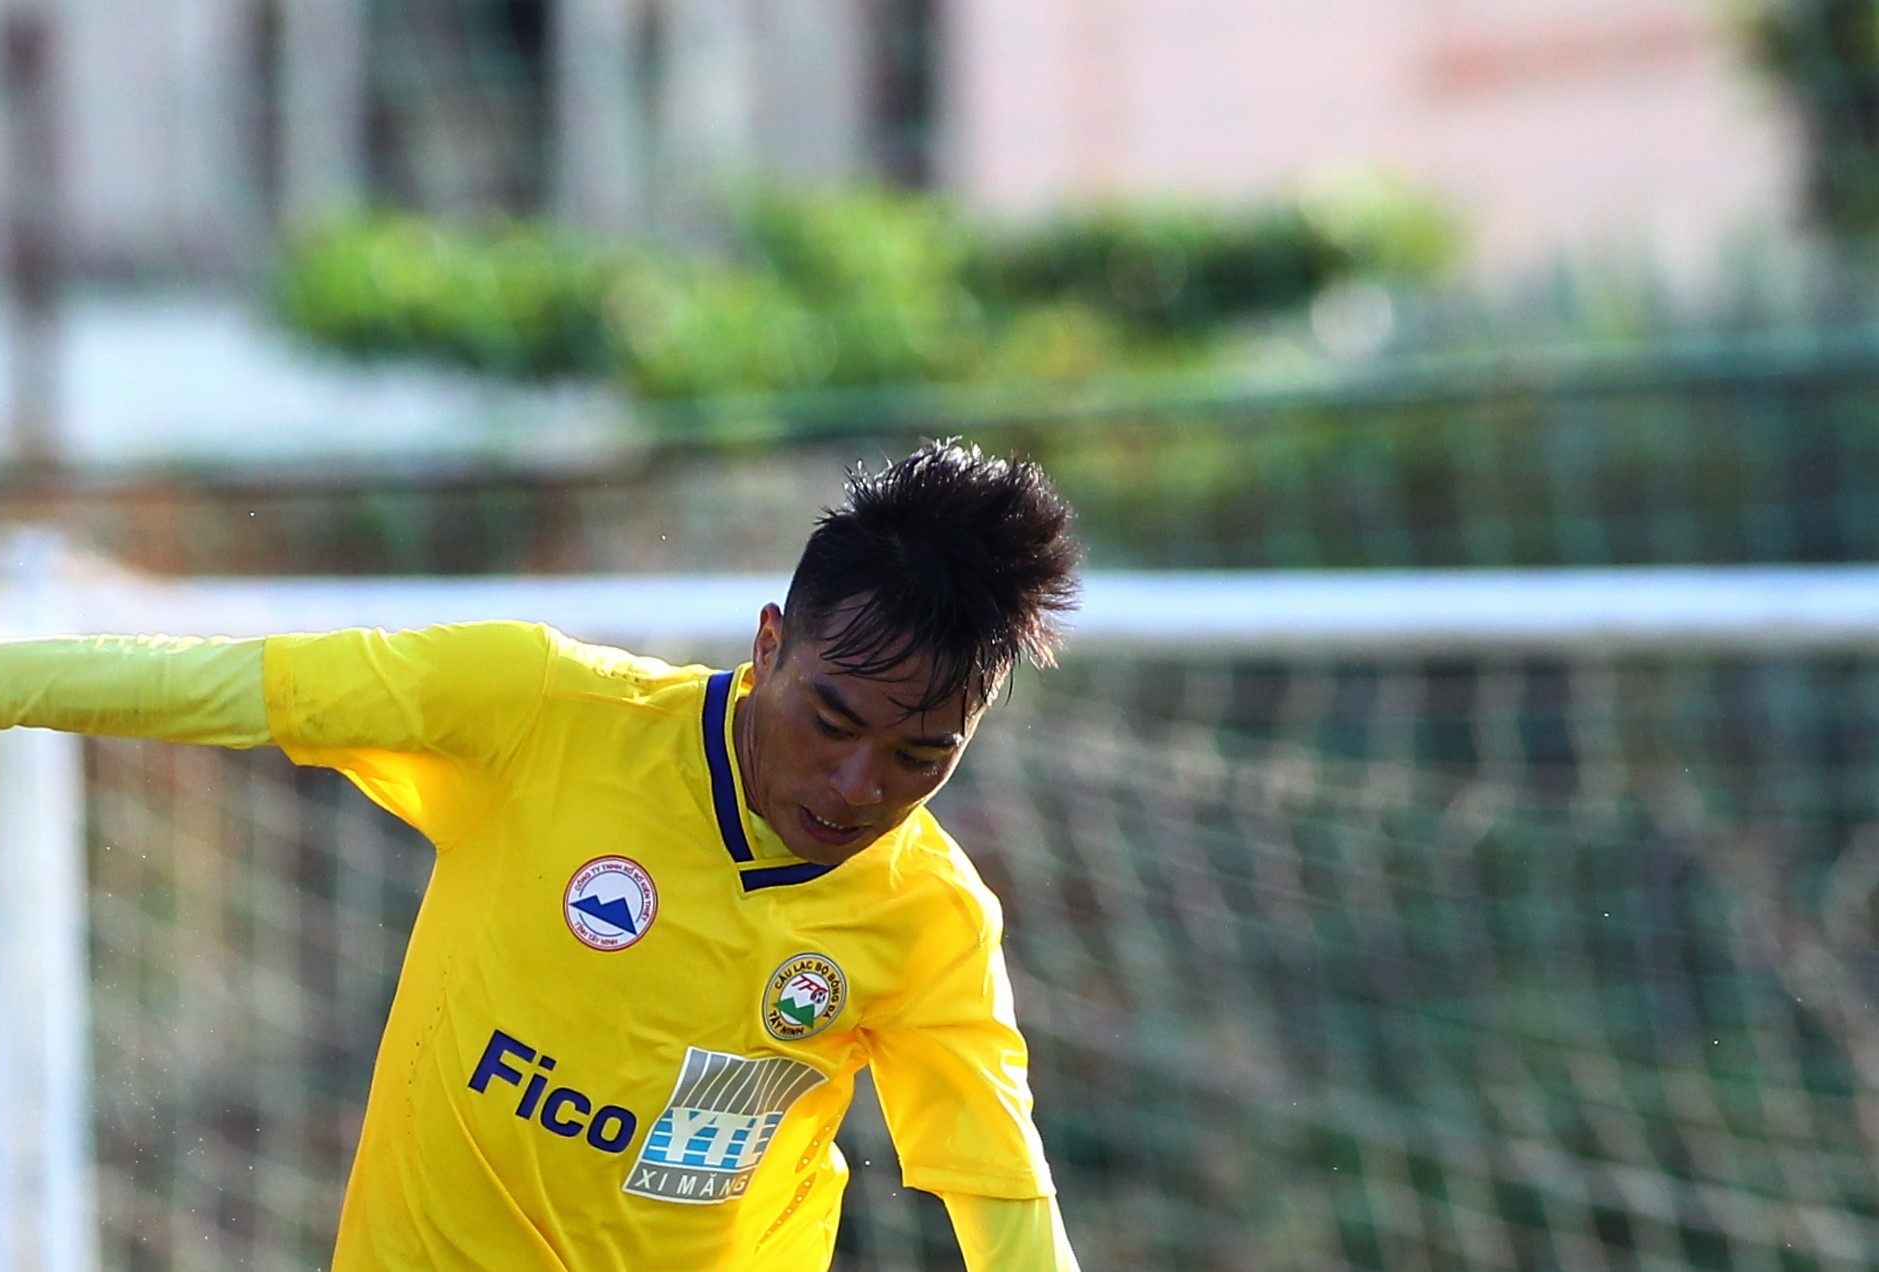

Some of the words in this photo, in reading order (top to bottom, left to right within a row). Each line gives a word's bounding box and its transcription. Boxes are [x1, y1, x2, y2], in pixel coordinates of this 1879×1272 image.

[467, 1028, 638, 1154] Fico
[634, 1168, 670, 1193] XI
[676, 1173, 749, 1197] MĂNG
